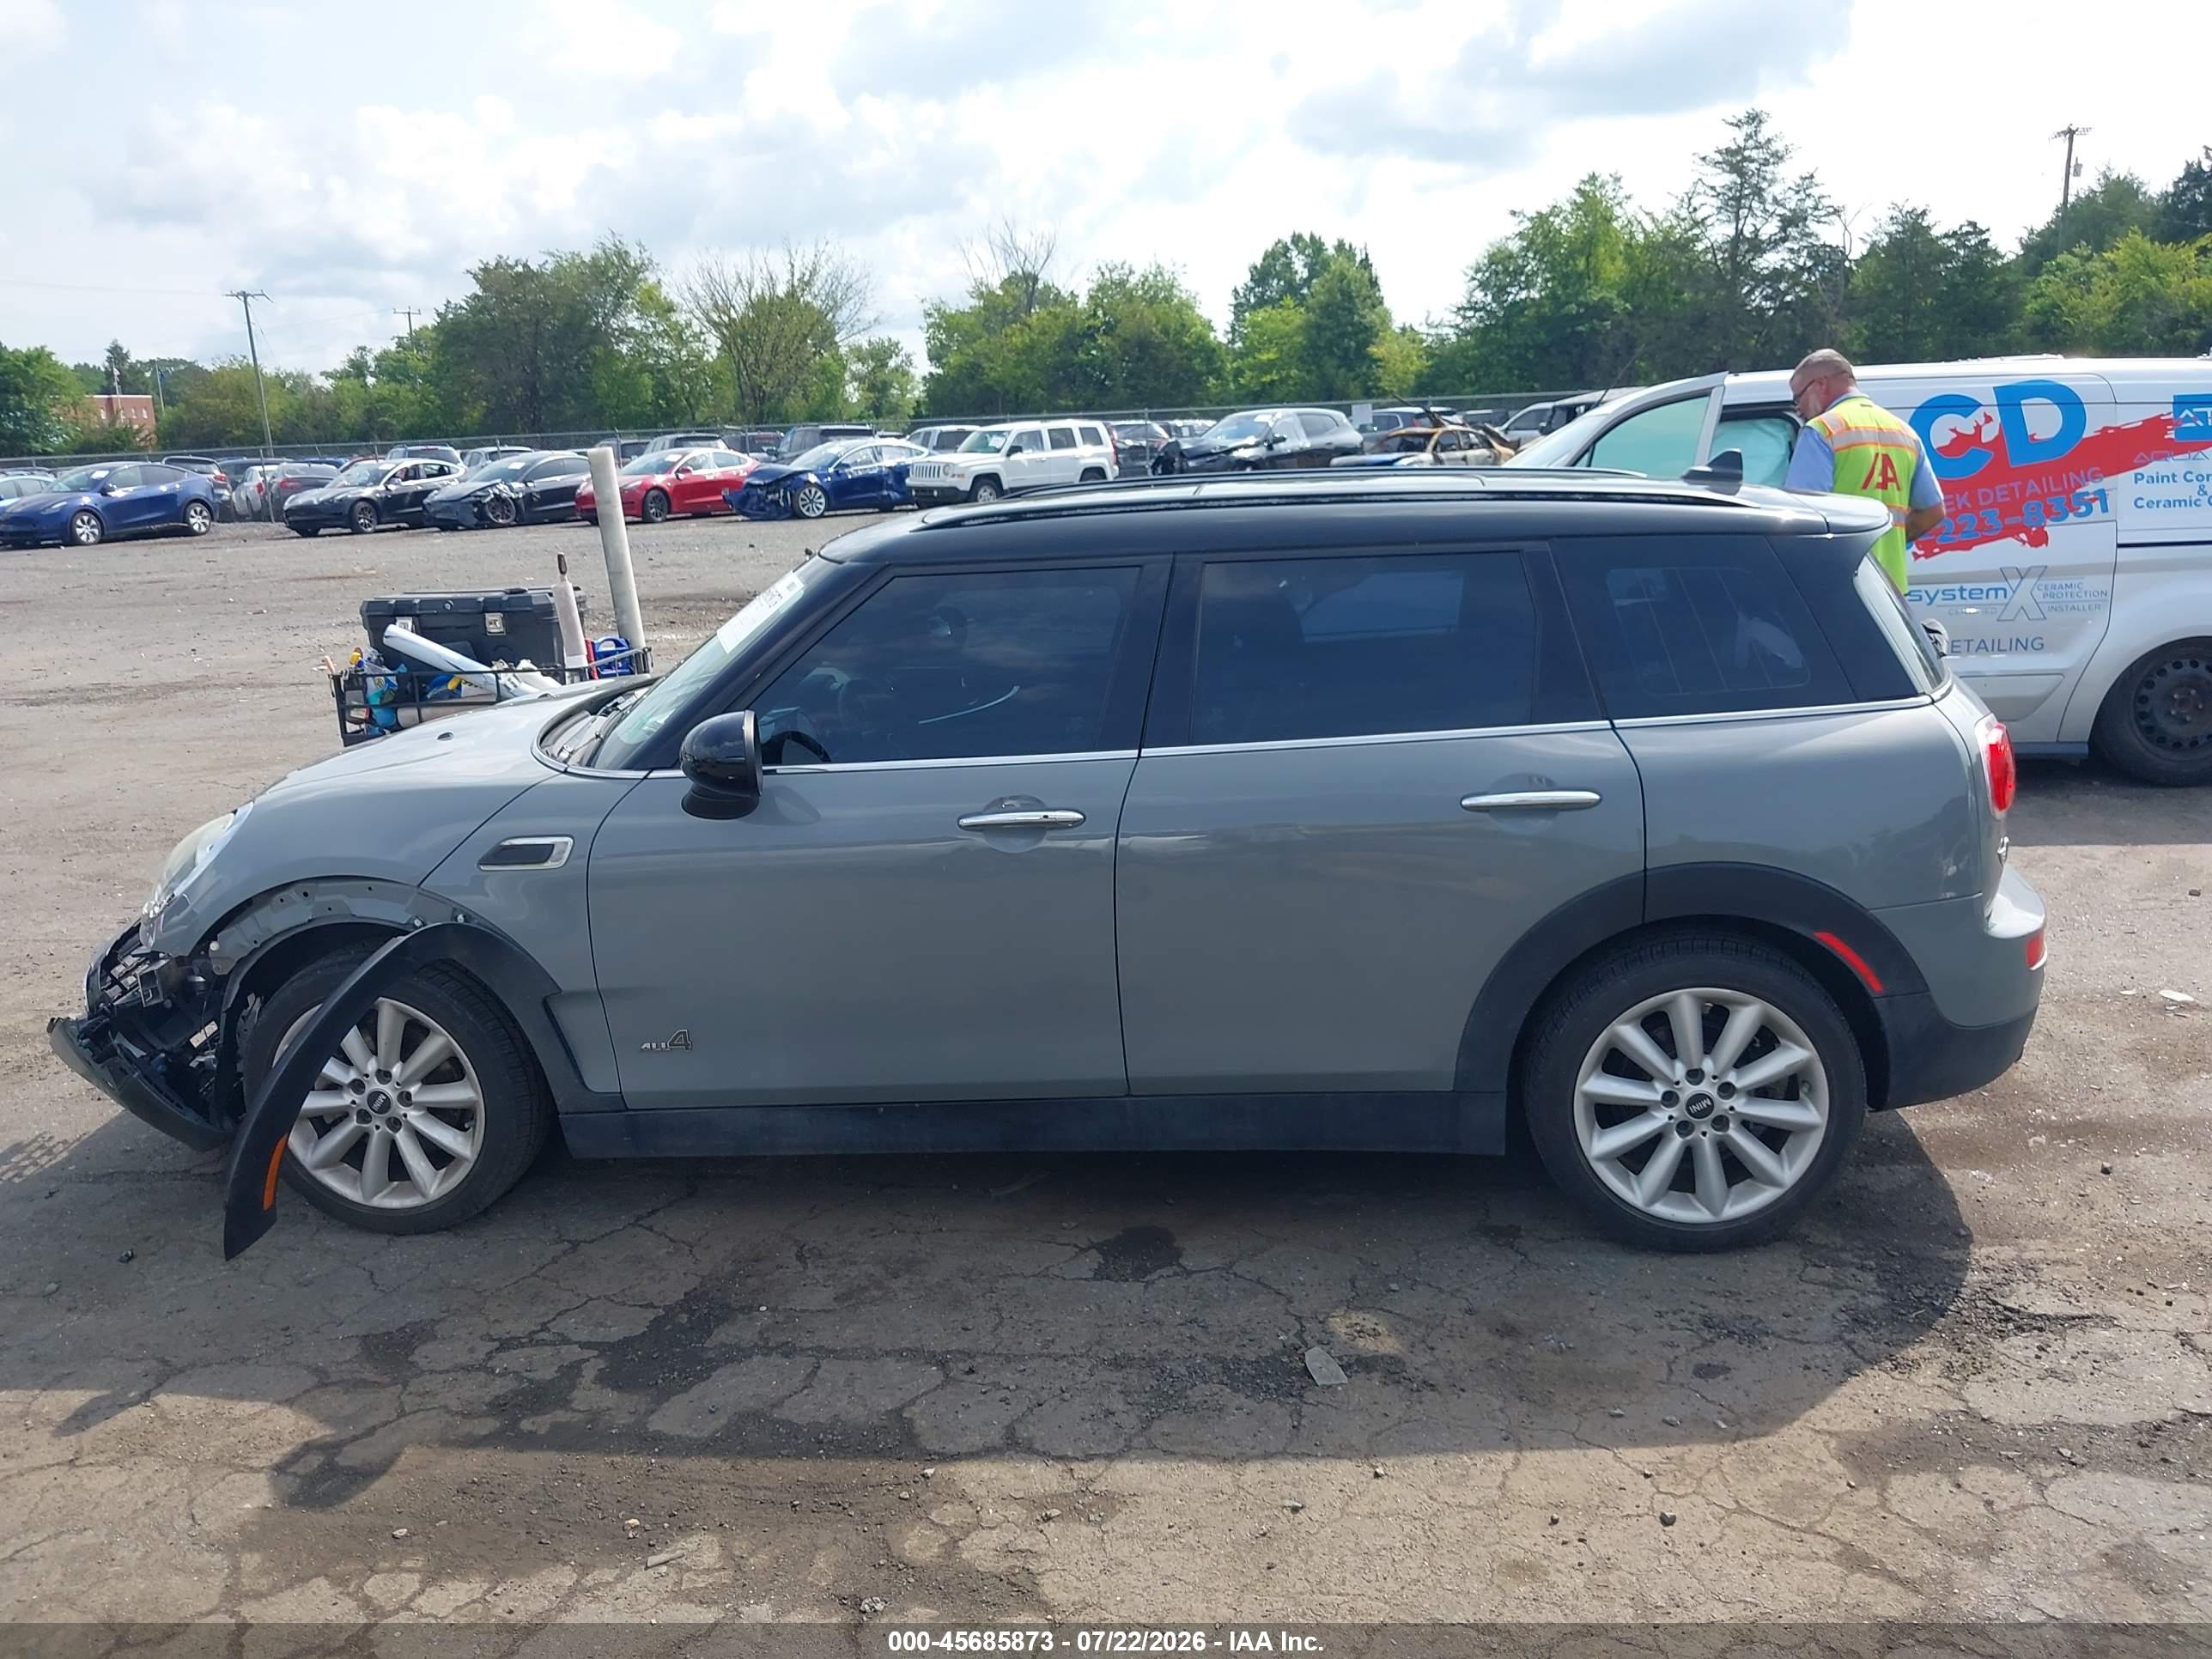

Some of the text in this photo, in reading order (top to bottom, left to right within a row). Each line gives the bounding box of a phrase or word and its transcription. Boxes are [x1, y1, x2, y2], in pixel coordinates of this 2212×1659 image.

[2133, 471, 2178, 484] Paint
[1977, 466, 2105, 507] DETAILING
[2197, 483, 2208, 496] &
[2133, 495, 2203, 509] Ceramic
[2036, 581, 2084, 592] CERAMIC
[2042, 590, 2108, 599] PROTECTION
[2047, 603, 2102, 612] INSTALLER
[1949, 636, 2045, 654] ETAILING
[1688, 1097, 1712, 1114] MINI
